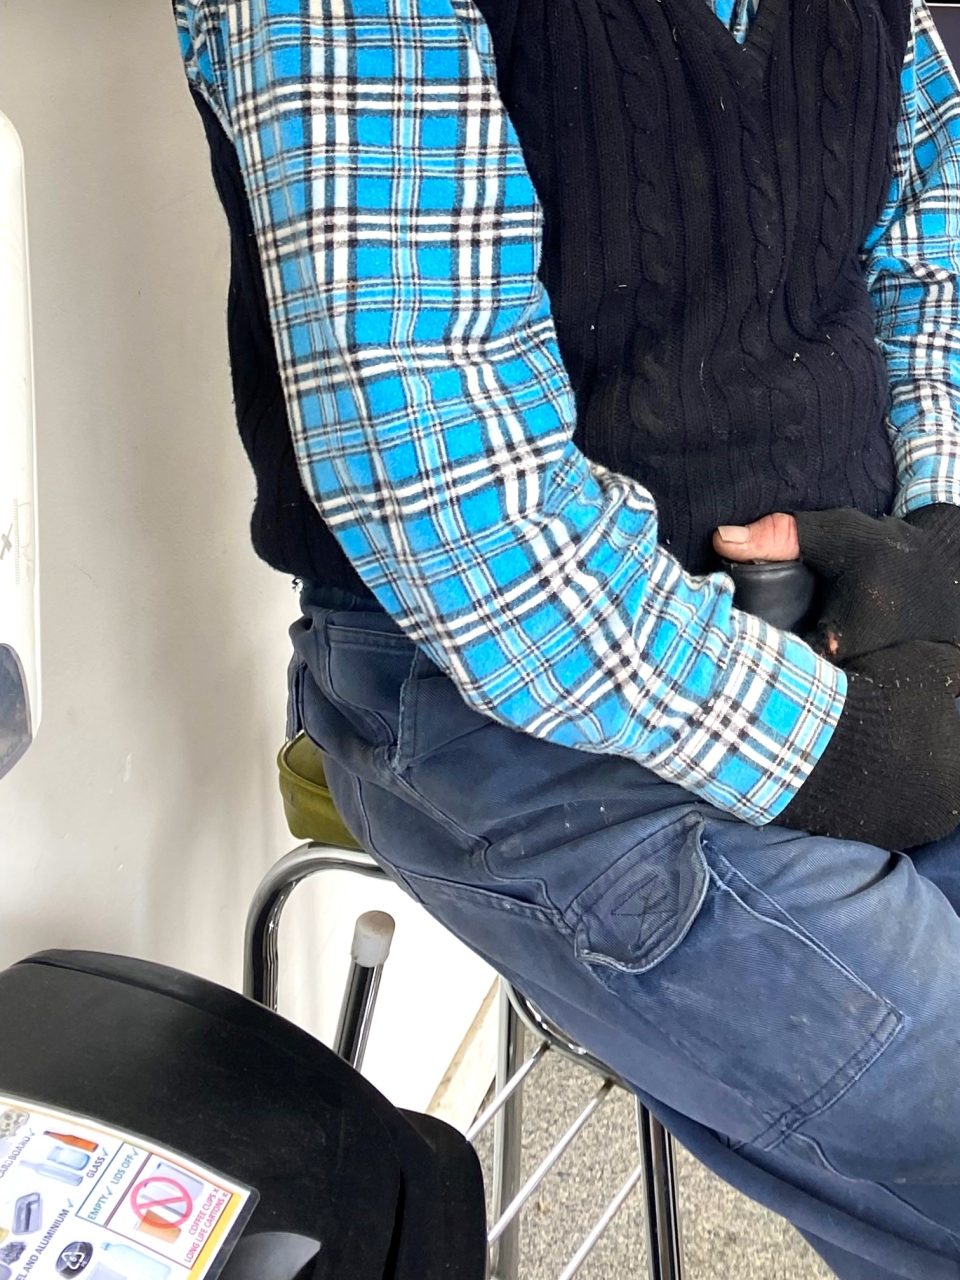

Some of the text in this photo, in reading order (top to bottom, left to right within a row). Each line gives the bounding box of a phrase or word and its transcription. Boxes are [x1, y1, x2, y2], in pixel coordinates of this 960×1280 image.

[86, 1153, 106, 1179] GLASS
[87, 1193, 110, 1221] EMPTY
[110, 1164, 125, 1185] LIDS
[25, 1252, 40, 1273] AND
[37, 1208, 70, 1255] ALUMINIUM
